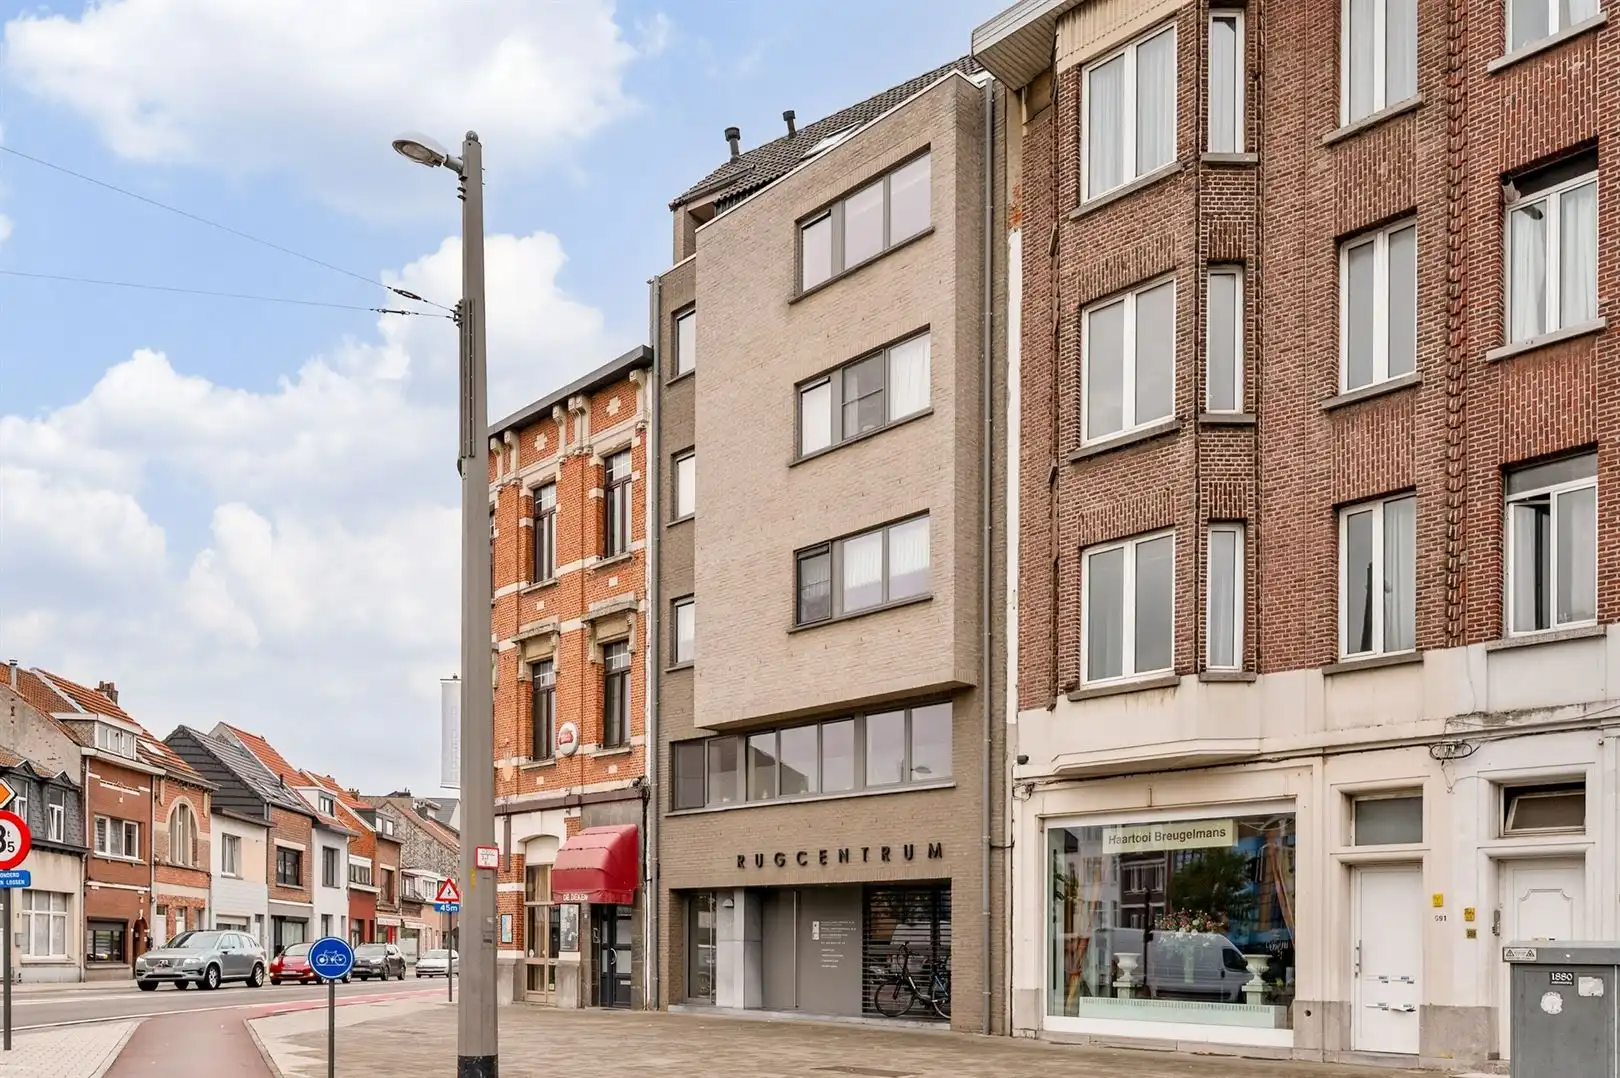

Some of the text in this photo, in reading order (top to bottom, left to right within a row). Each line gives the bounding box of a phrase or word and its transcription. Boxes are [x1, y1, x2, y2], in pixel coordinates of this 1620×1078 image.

[1108, 828, 1226, 845] Haartooi Breugelmans
[737, 843, 943, 868] RUGCENTRUM
[440, 904, 458, 912] 45m
[1551, 972, 1573, 981] 1880
